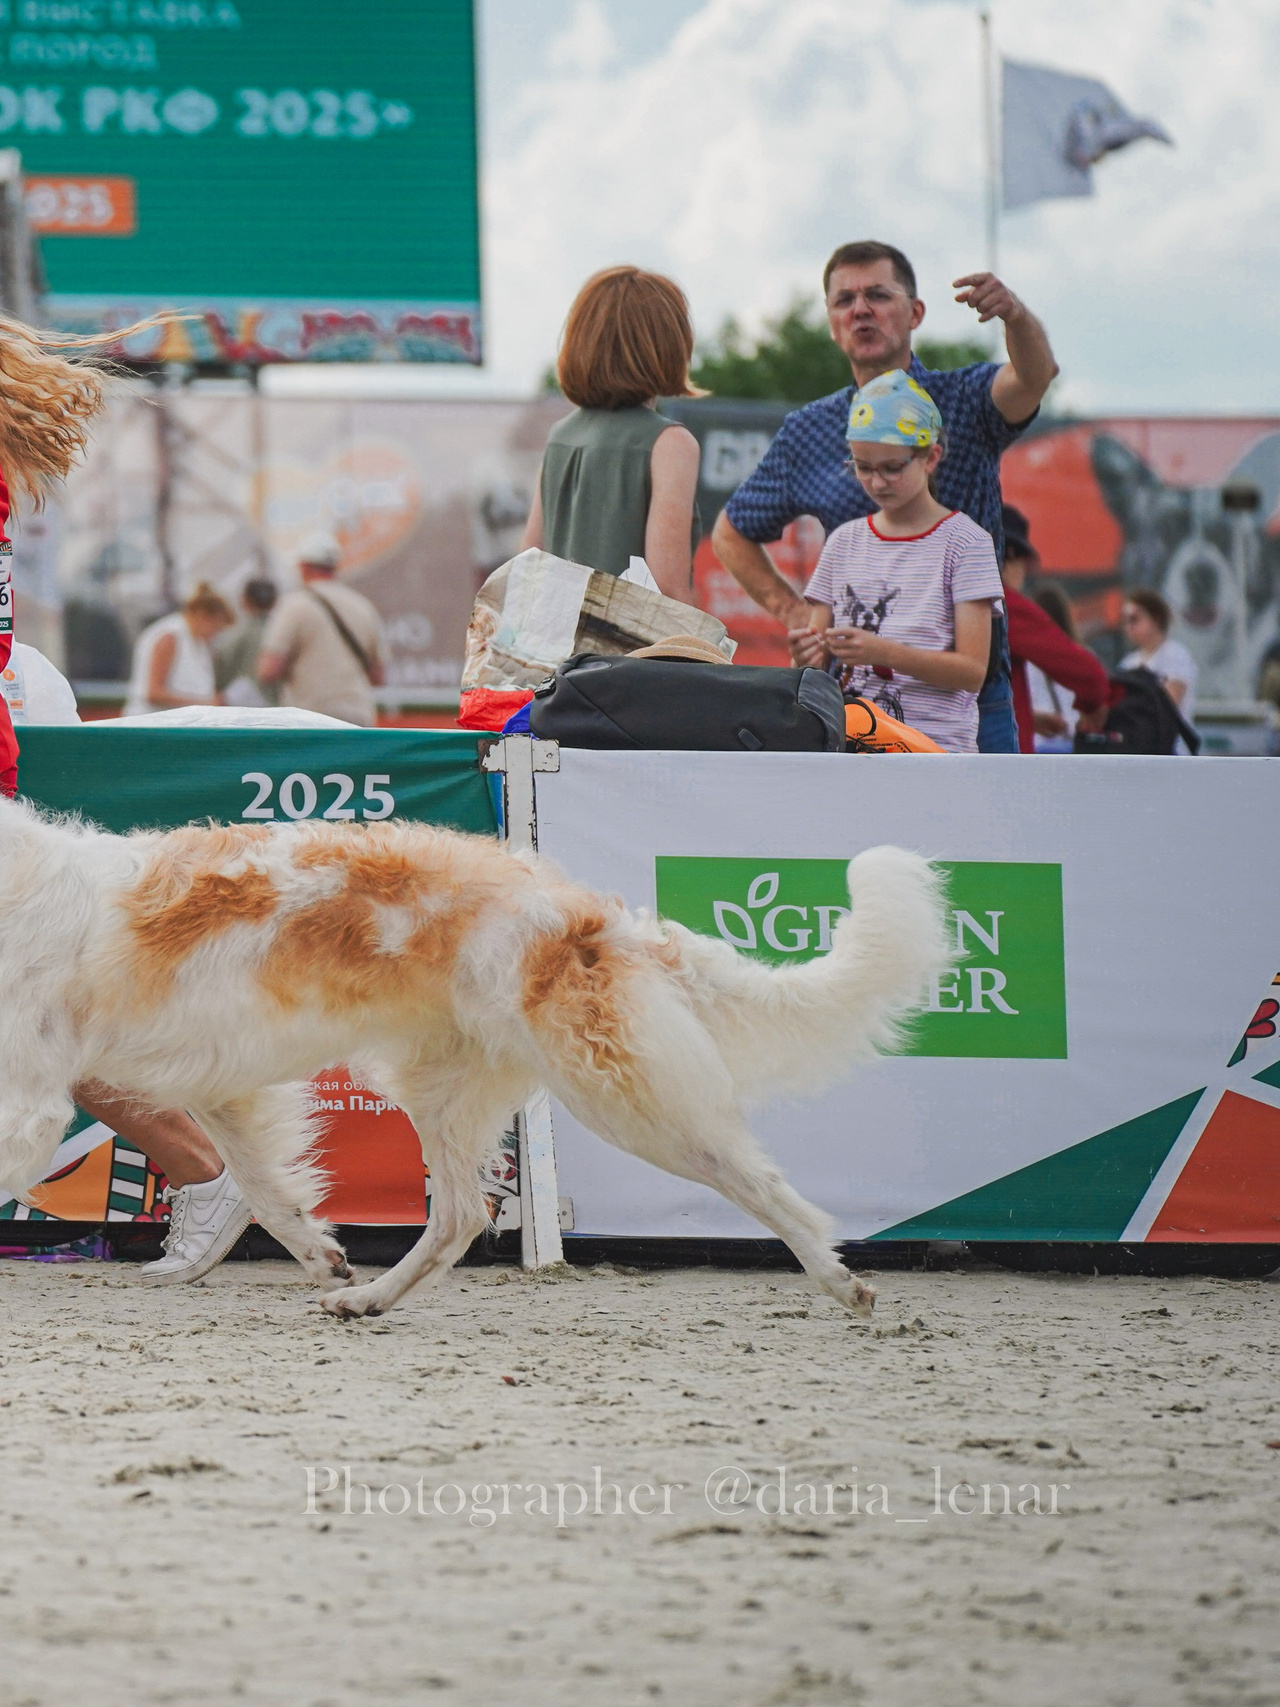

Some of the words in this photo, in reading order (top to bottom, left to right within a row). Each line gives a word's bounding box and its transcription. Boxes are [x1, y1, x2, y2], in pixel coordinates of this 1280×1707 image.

[9, 32, 157, 70] ПОРОД
[81, 85, 219, 135] РКФ
[235, 87, 413, 137] 2025»
[241, 771, 395, 820] 2025
[762, 904, 1005, 956] GRN
